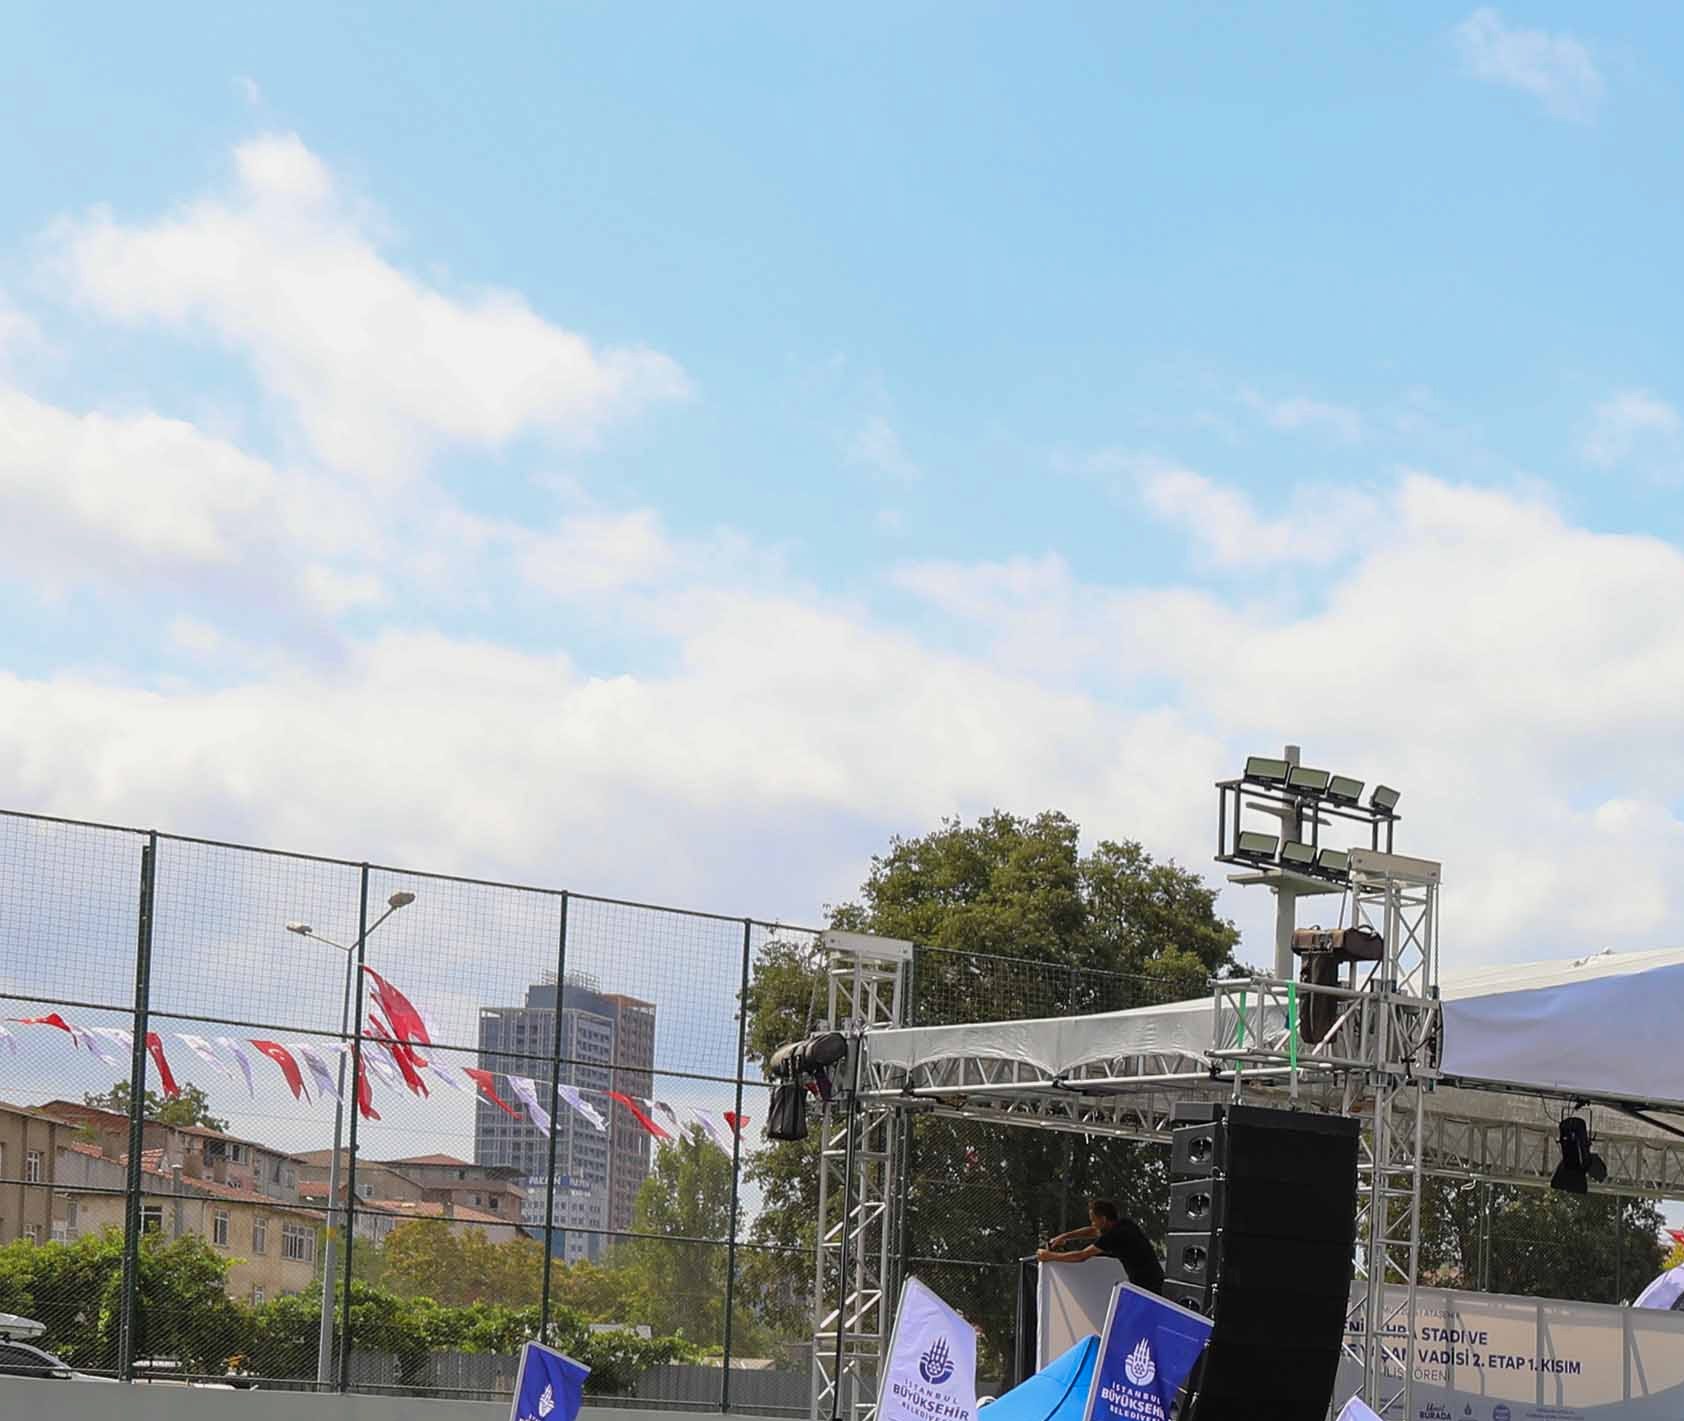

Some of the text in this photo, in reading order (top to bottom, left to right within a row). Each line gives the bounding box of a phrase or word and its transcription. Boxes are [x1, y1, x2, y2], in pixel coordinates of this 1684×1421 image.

[1466, 1331, 1488, 1346] VE
[1418, 1346, 1470, 1367] VADİSİ
[1473, 1353, 1485, 1368] 2.
[1488, 1355, 1526, 1371] ETAP
[1540, 1359, 1582, 1376] KISIM
[892, 1383, 969, 1421] BÜYÜKŞEHİR
[904, 1378, 959, 1404] İSTANBUL
[1112, 1382, 1161, 1404] İSTANBUL
